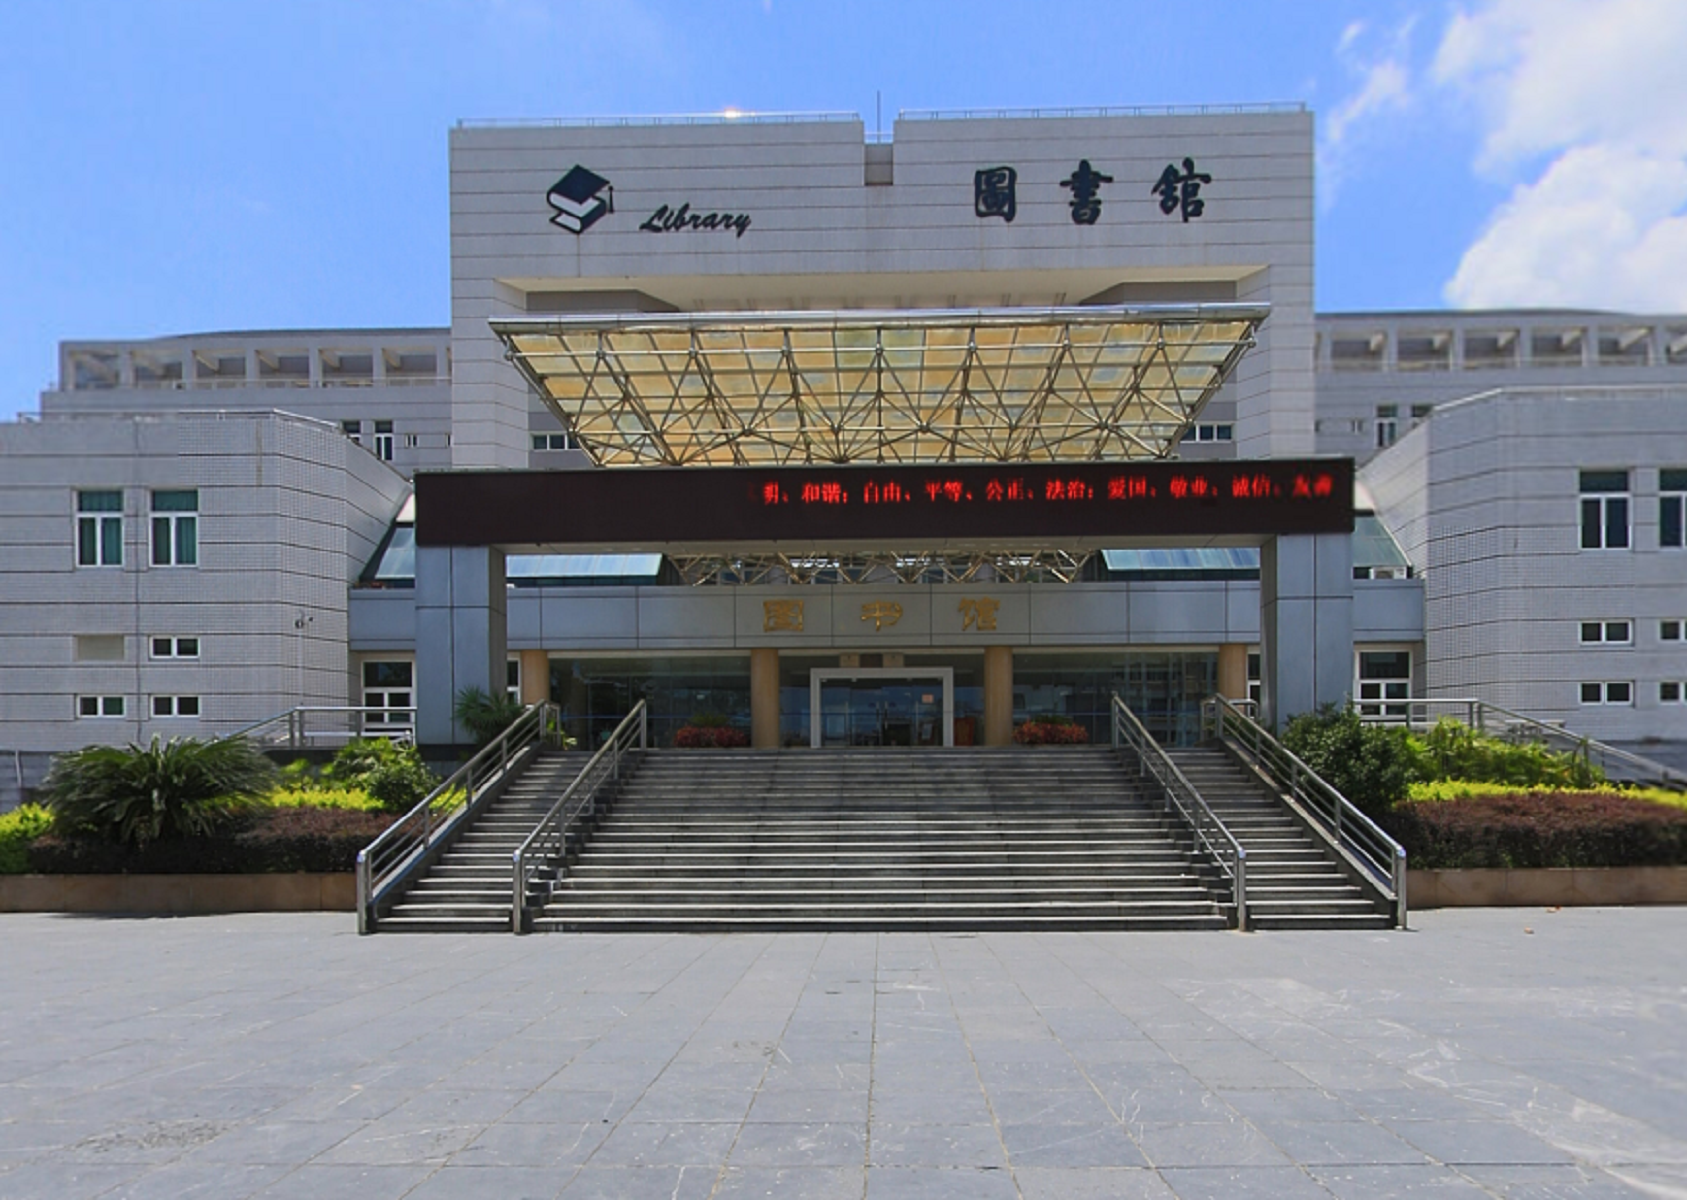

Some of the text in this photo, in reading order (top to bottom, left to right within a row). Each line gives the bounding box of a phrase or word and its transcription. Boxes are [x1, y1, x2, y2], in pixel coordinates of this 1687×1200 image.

[974, 157, 1212, 225] 圖書館
[639, 202, 752, 238] Library
[763, 596, 1001, 632] 图书馆
